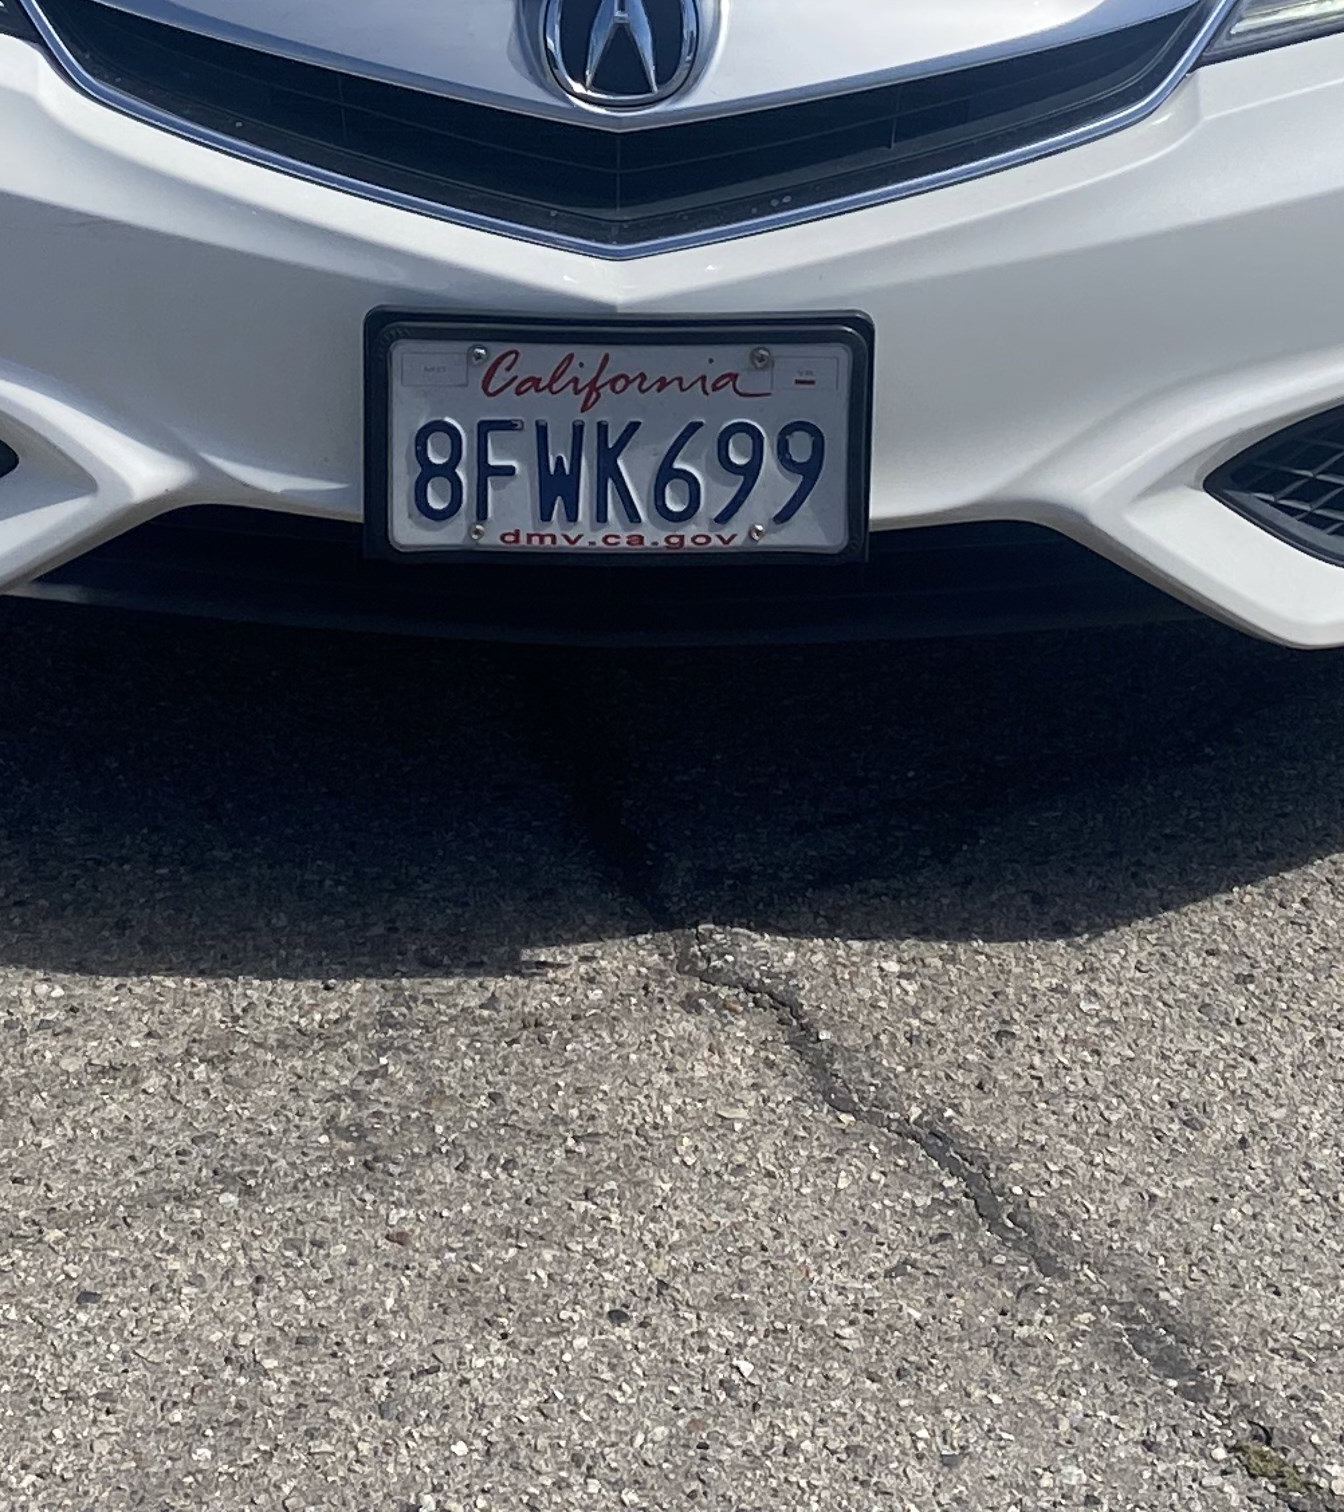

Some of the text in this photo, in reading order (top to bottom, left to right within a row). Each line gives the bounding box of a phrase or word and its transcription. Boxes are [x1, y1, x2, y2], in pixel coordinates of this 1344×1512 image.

[480, 349, 772, 413] California
[413, 419, 826, 525] 8FWK699
[498, 528, 738, 550] dmv.ca.gov
